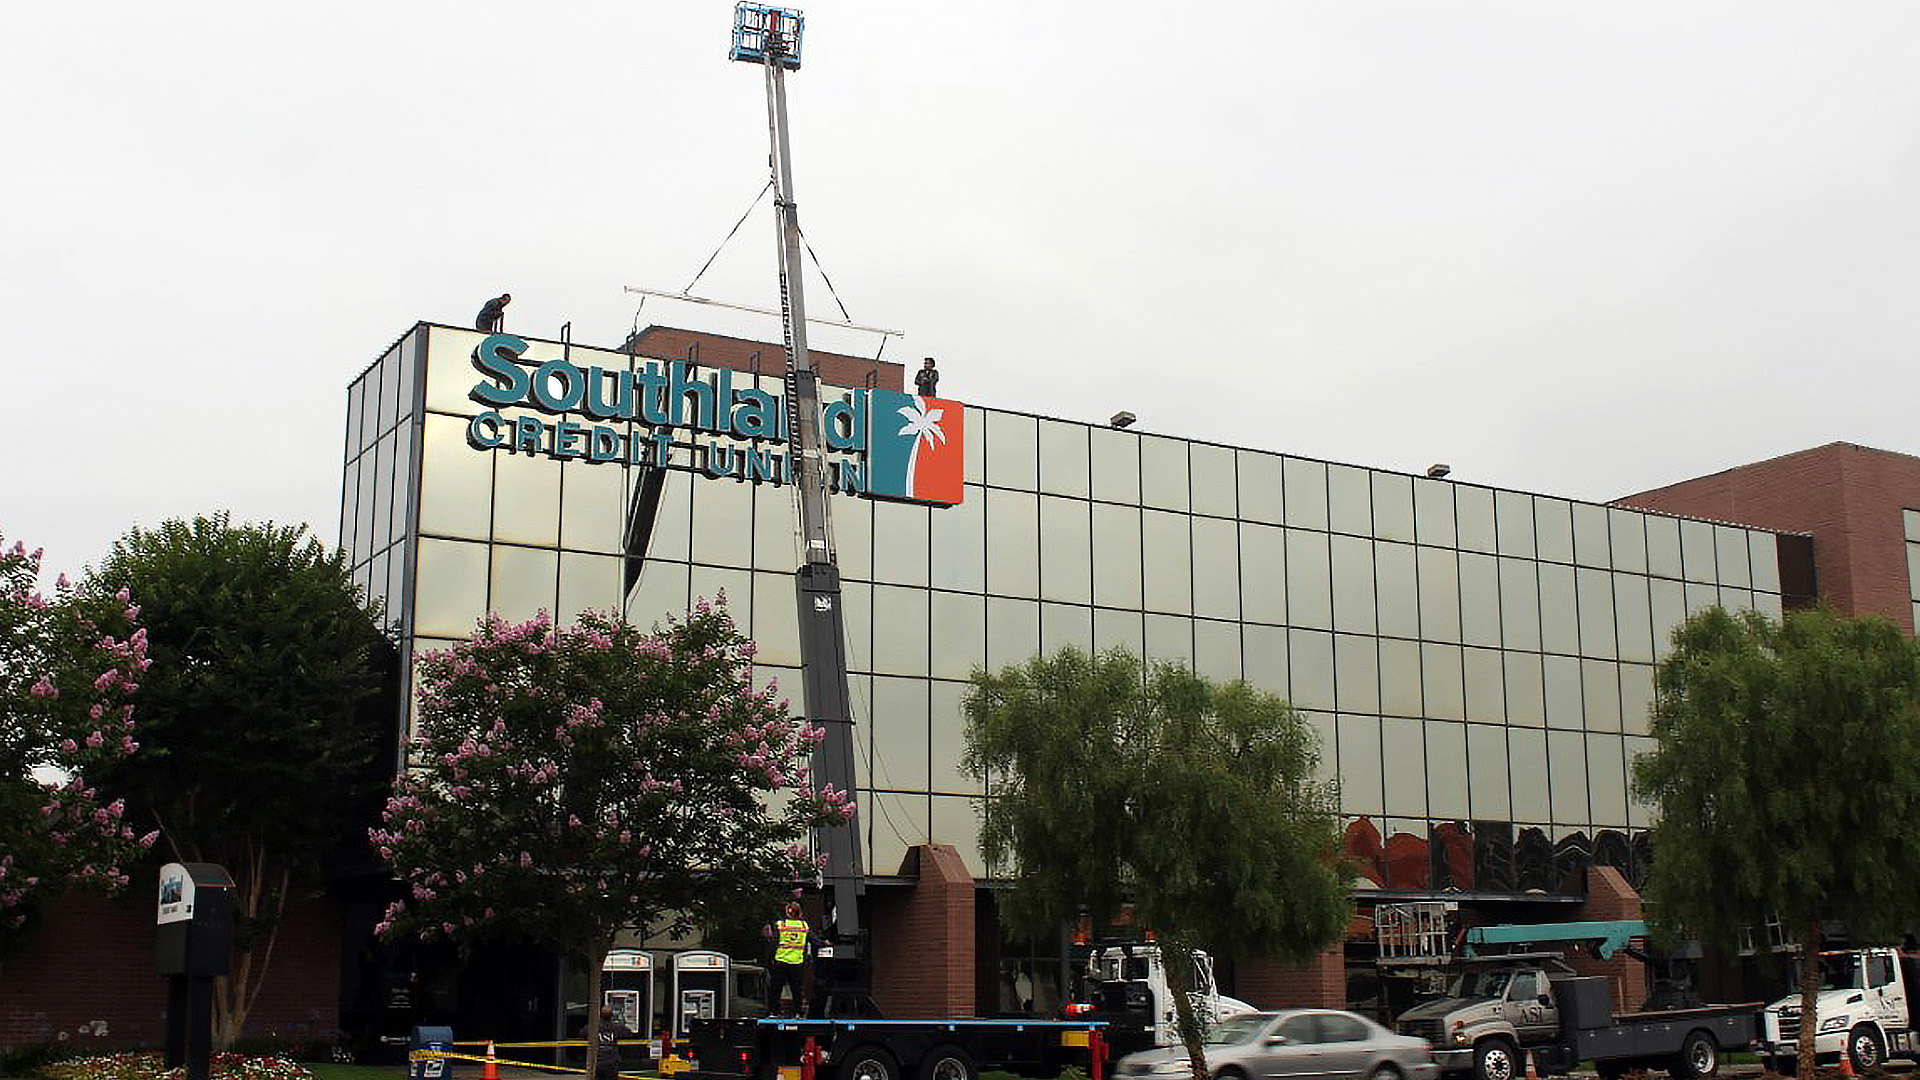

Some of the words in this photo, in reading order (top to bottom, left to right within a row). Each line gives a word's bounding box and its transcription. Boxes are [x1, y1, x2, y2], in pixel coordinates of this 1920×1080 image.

[471, 332, 866, 451] Southlad
[470, 411, 674, 468] CREDIT
[707, 441, 866, 493] UNIN
